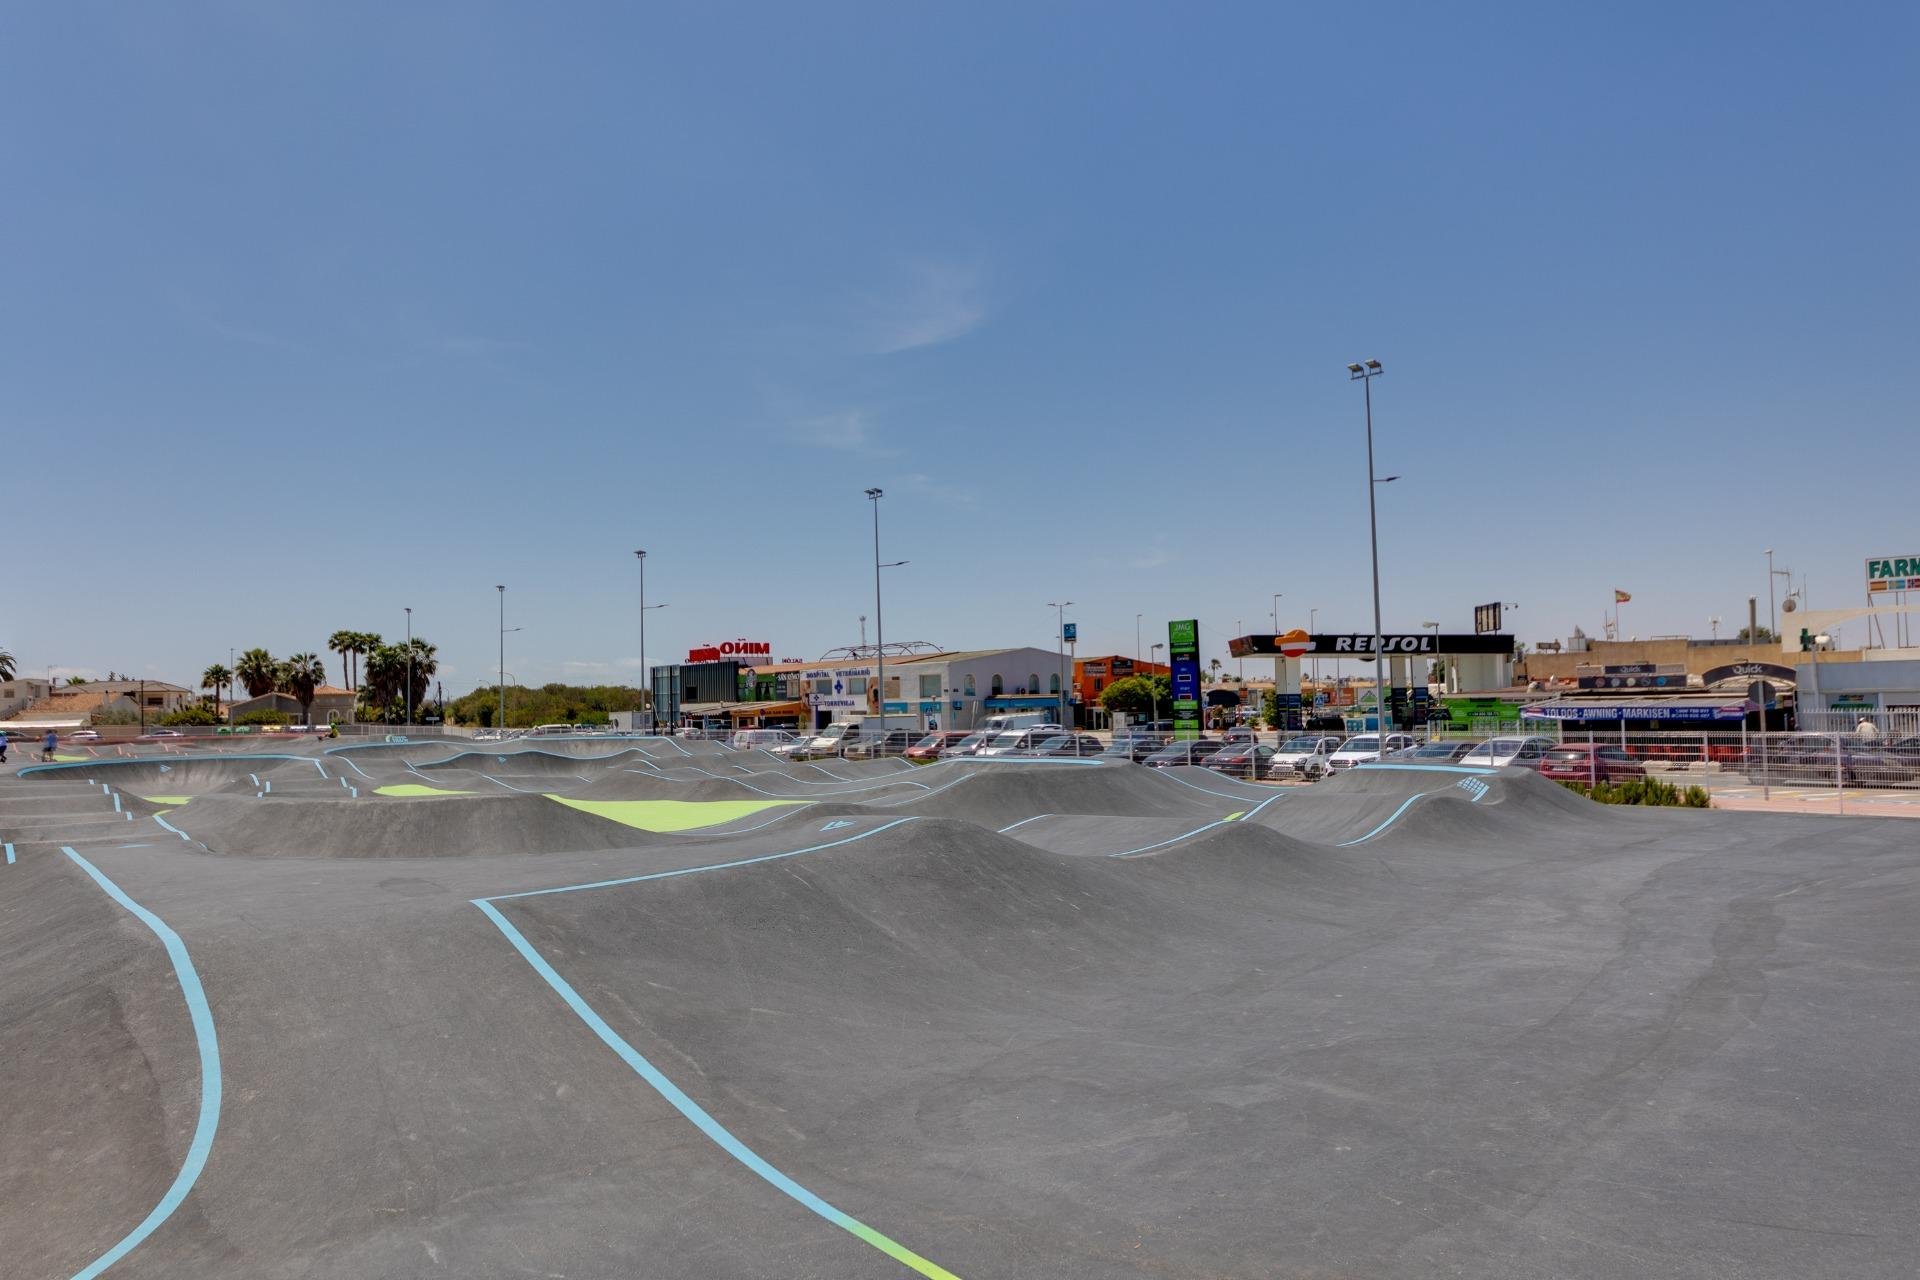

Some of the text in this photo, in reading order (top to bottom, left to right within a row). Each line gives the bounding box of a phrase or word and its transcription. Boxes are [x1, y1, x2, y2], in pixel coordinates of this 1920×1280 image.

[1335, 637, 1431, 651] REPSOL
[806, 670, 830, 679] HOSPITAL
[835, 668, 871, 678] VETERINARIO
[1619, 666, 1641, 674] Quick
[1731, 664, 1763, 676] Quick
[1545, 707, 1578, 719] TOLDOS
[1583, 707, 1618, 719] AWNING
[1622, 708, 1670, 719] MARKISEN
